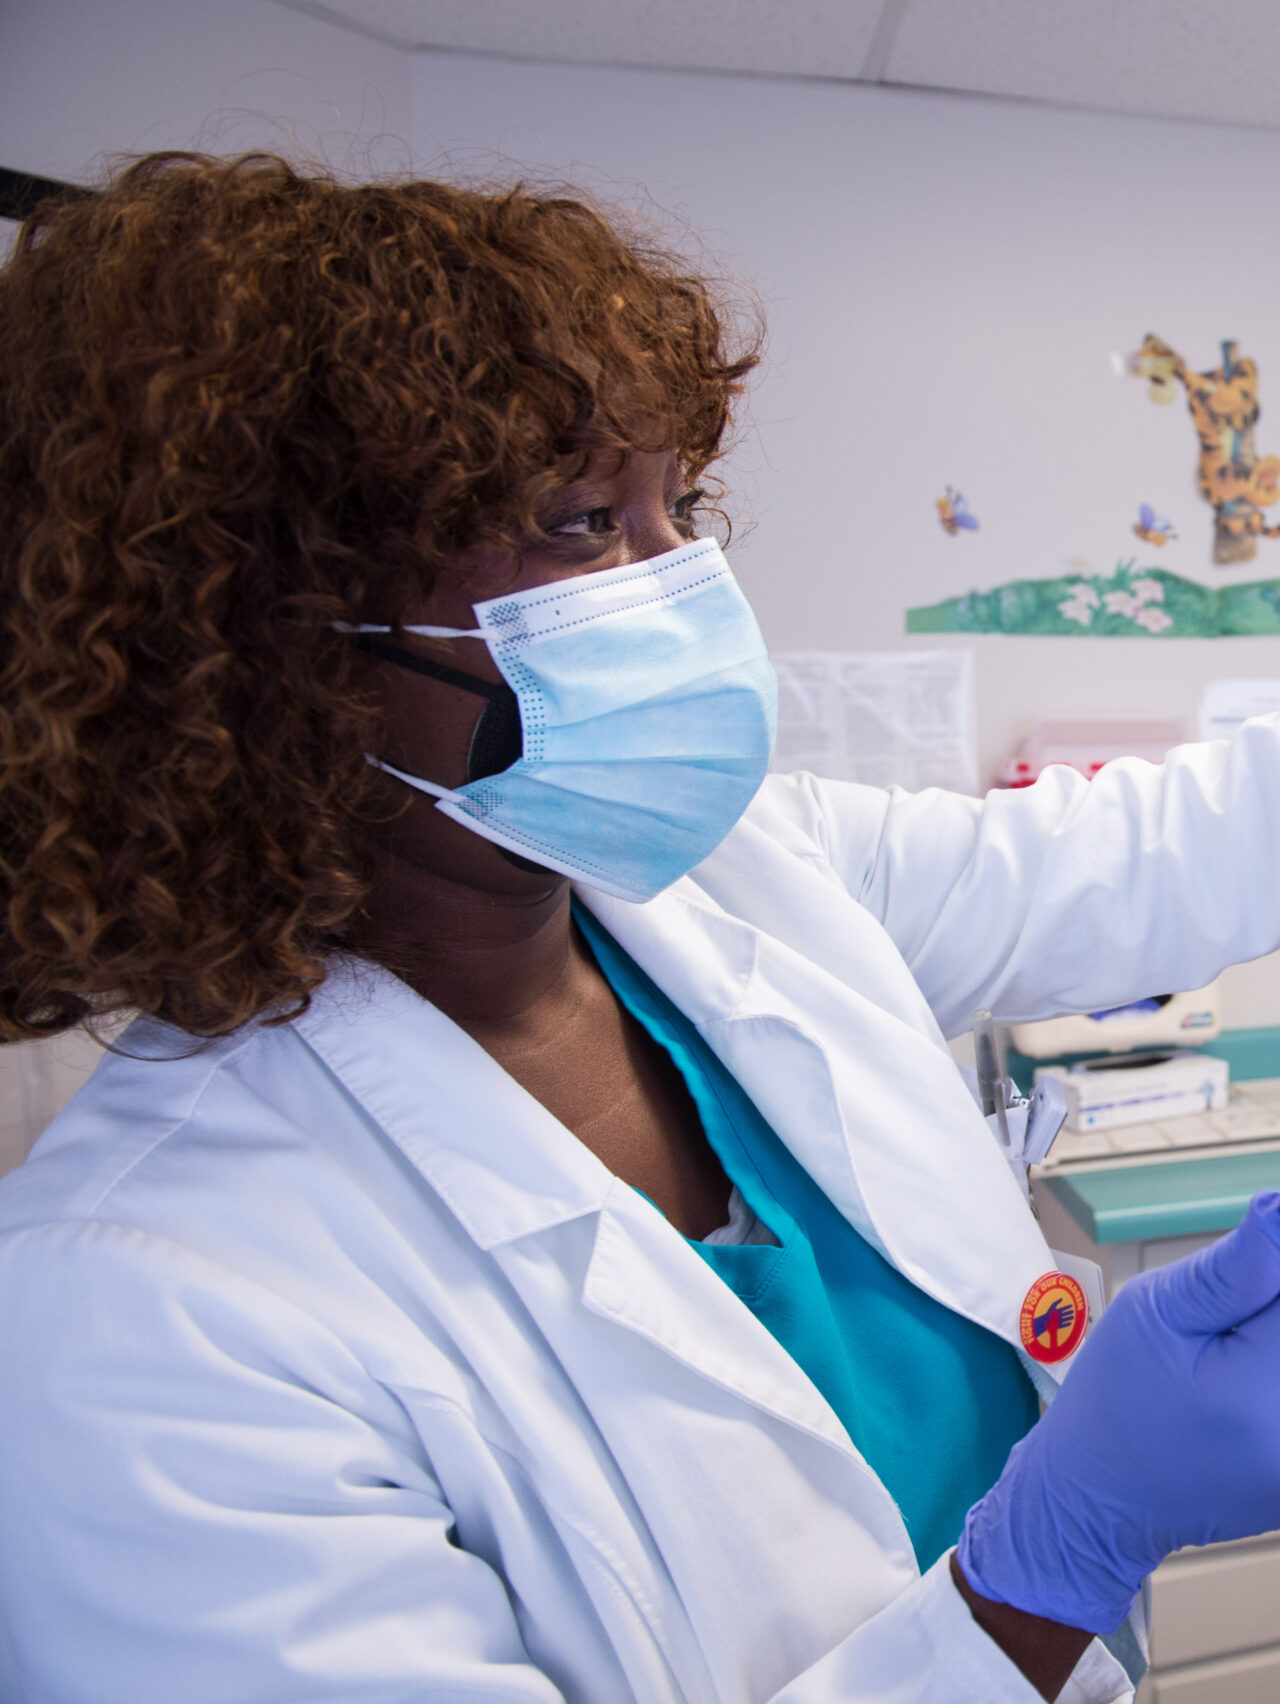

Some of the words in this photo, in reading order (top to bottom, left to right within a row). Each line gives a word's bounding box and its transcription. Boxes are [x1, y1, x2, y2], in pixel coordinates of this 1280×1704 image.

[1027, 1287, 1041, 1311] FOR
[1041, 1278, 1057, 1290] OUR
[1059, 1276, 1084, 1311] CHILDREN
